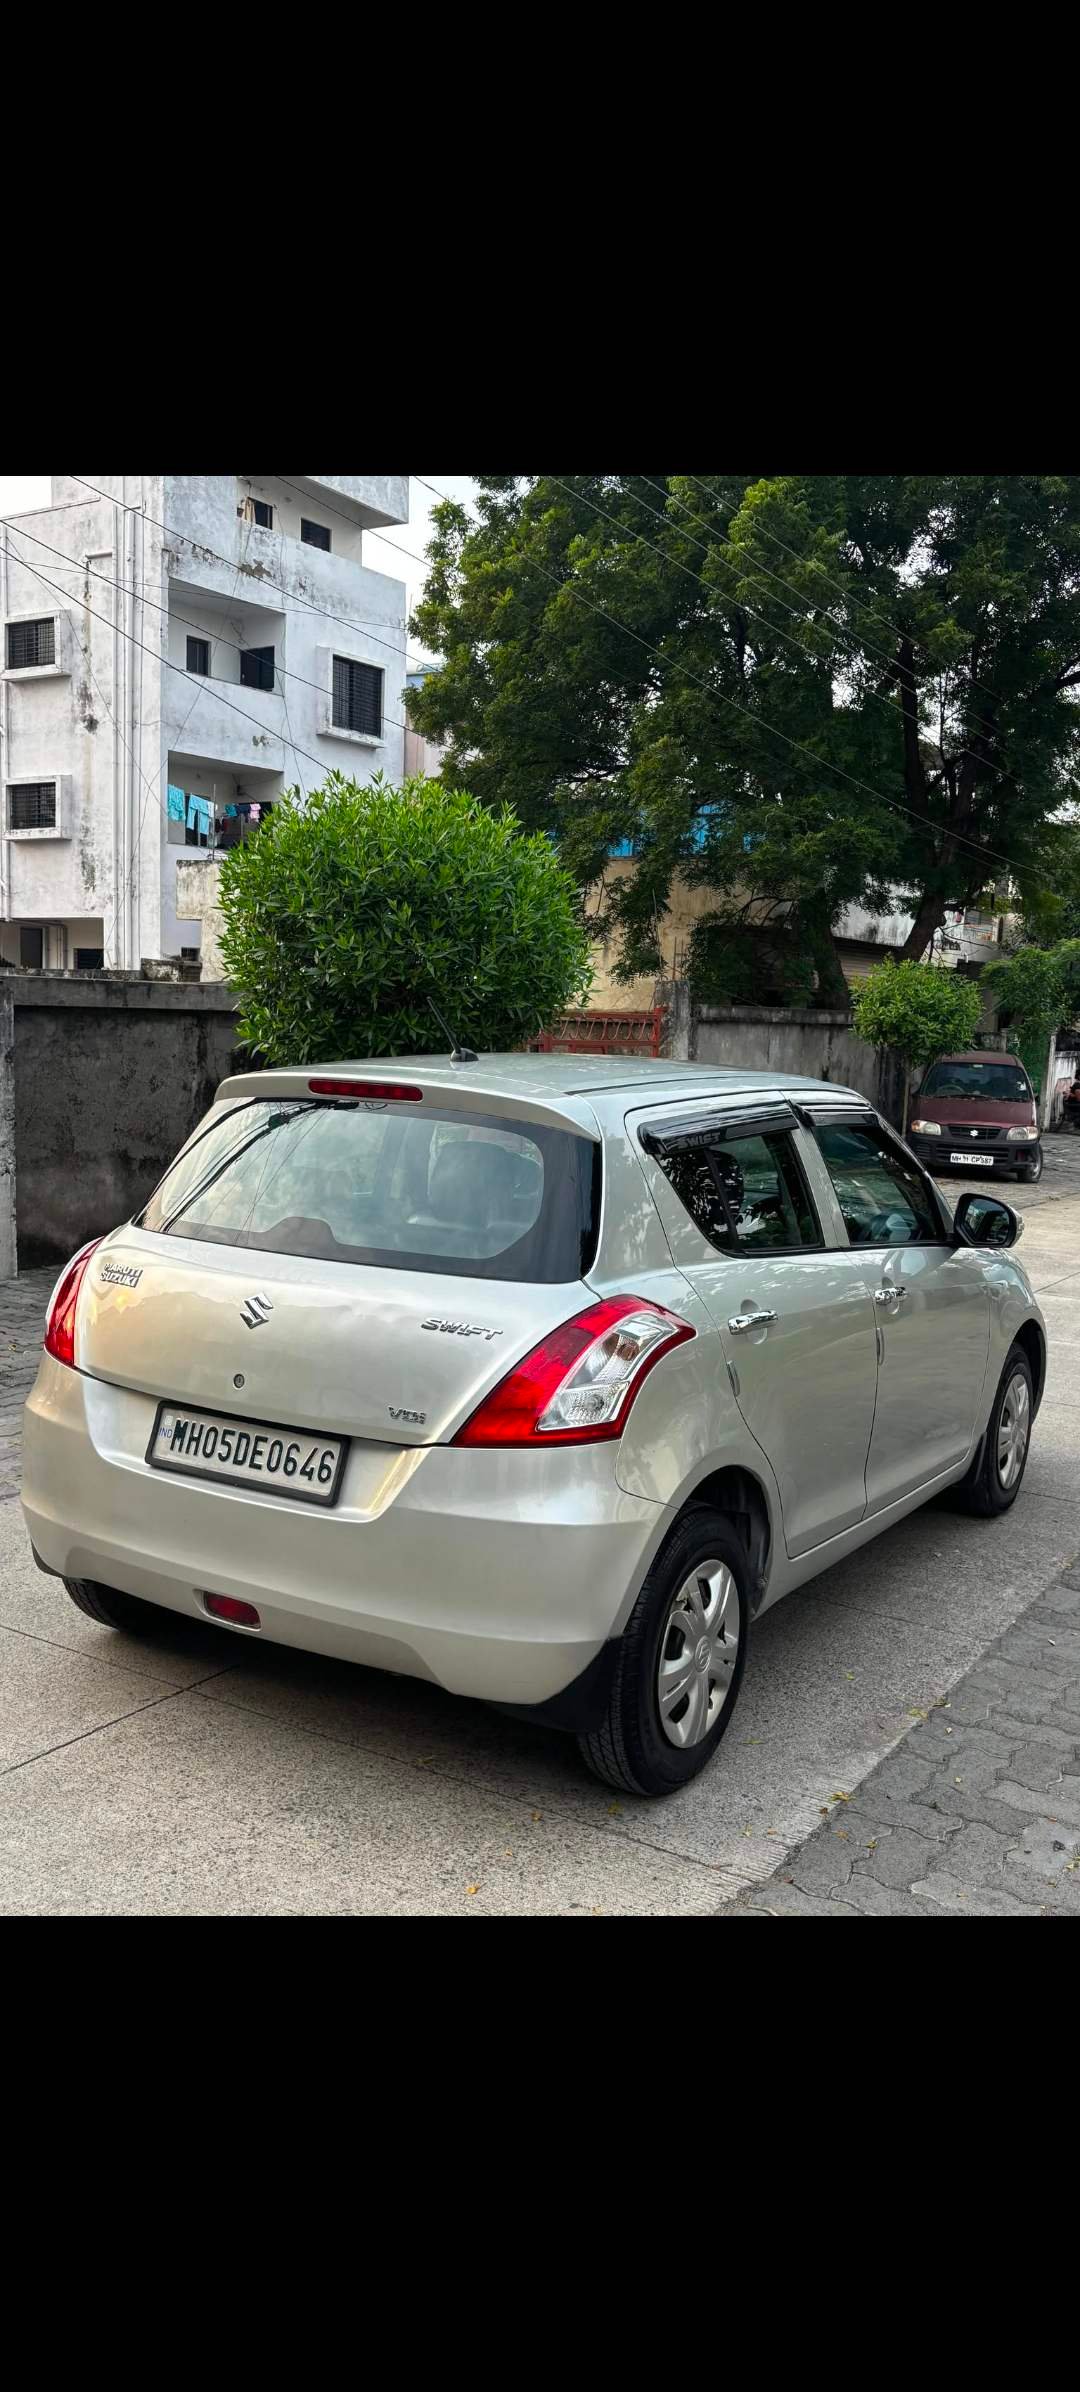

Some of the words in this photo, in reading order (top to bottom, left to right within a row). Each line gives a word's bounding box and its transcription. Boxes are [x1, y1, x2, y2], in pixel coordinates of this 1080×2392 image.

[104, 1263, 143, 1278] MARUTI
[100, 1272, 139, 1288] SUZUKI
[421, 1318, 503, 1340] SWIFT
[159, 1427, 172, 1438] IND
[170, 1419, 335, 1484] MH05DE0646
